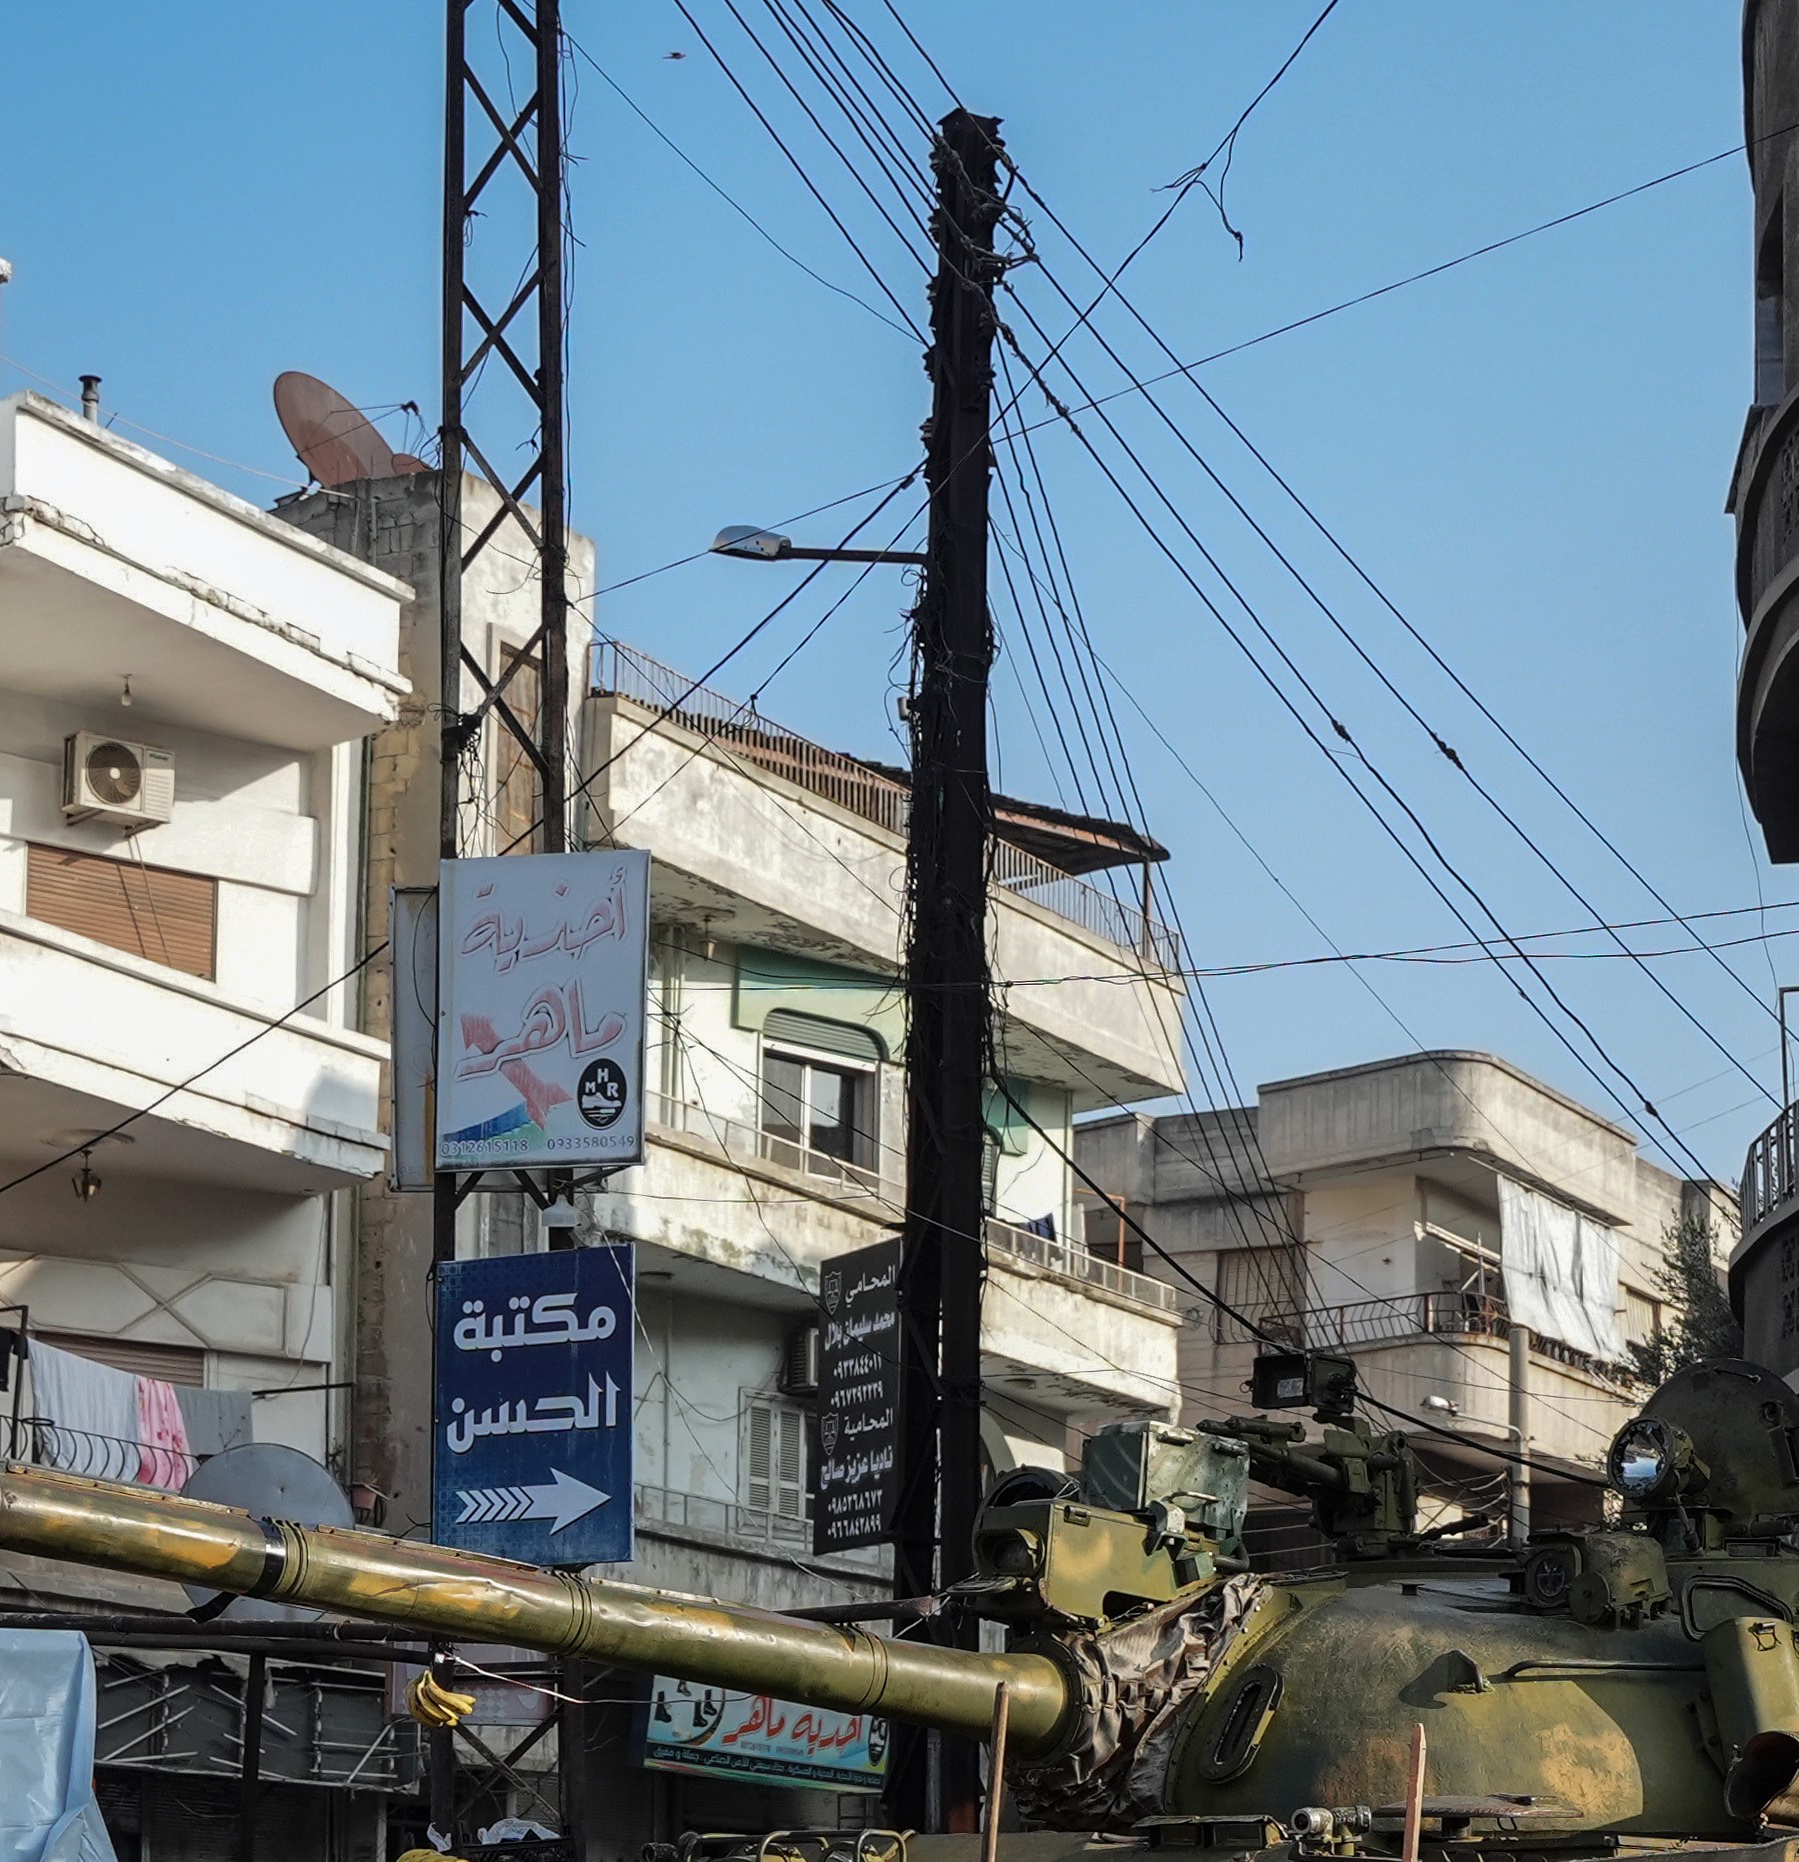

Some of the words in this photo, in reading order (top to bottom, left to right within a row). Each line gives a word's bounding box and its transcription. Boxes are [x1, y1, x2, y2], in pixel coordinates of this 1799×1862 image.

[460, 865, 628, 975] أحذية
[455, 977, 627, 1082] ماهر
[441, 1138, 529, 1157] 0312615118
[547, 1135, 635, 1150] 0933580549
[845, 1264, 895, 1308] المحامي
[454, 1292, 617, 1363] مكتبة
[447, 1371, 621, 1453] الحسن
[844, 1407, 893, 1442] المحامية
[820, 1458, 845, 1491] صالح
